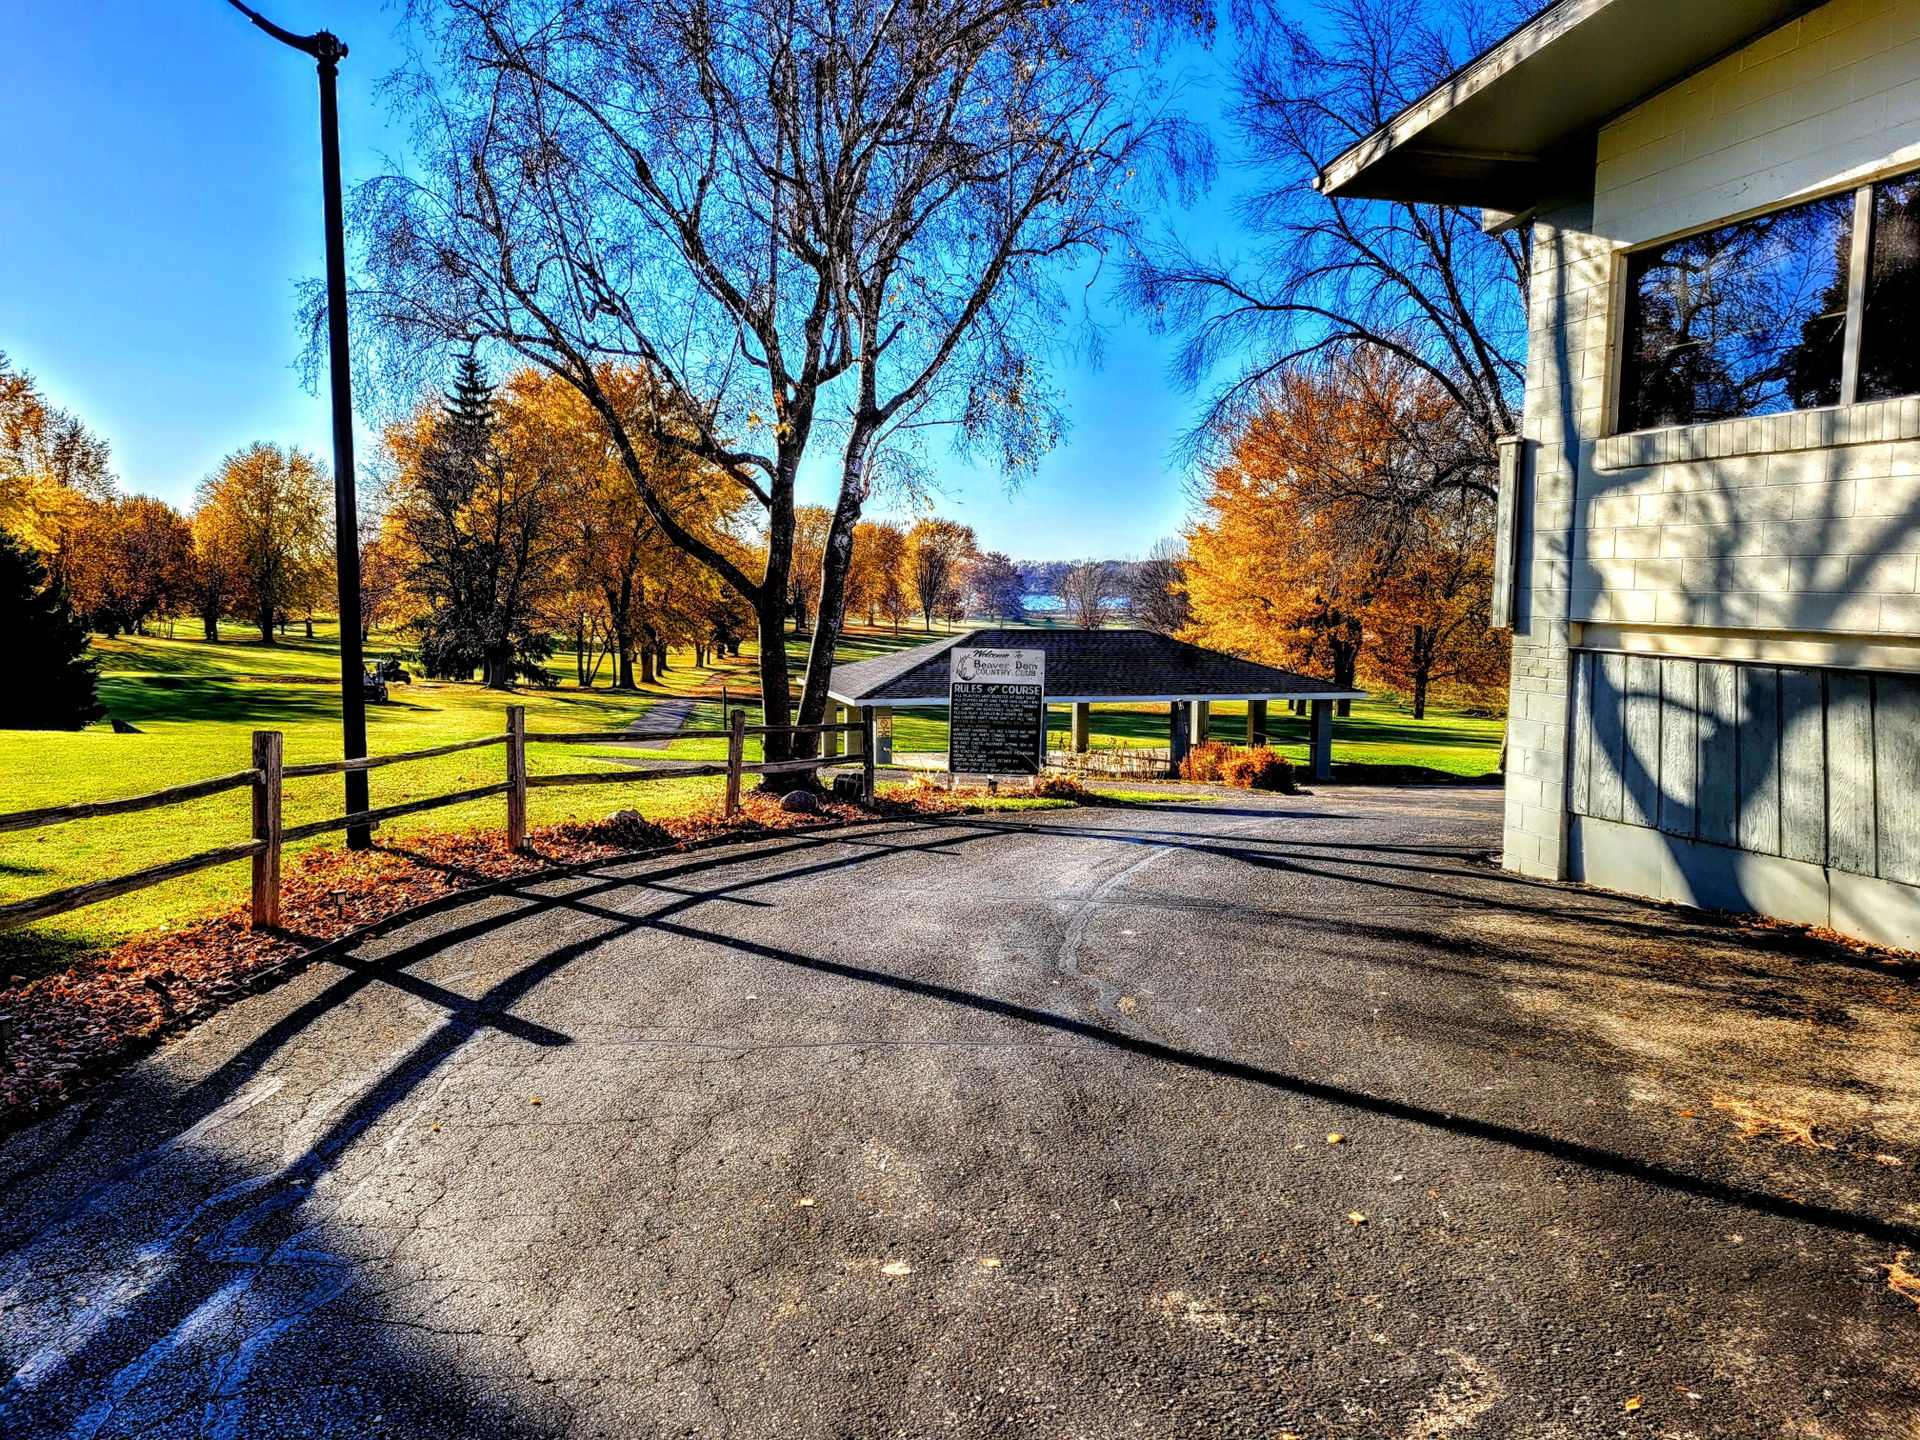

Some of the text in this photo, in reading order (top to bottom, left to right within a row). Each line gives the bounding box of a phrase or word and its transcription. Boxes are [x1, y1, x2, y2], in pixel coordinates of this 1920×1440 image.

[972, 650, 1010, 658] Welcome
[974, 660, 1038, 670] Beaver Dam
[954, 684, 1040, 695] RULES of COURSE
